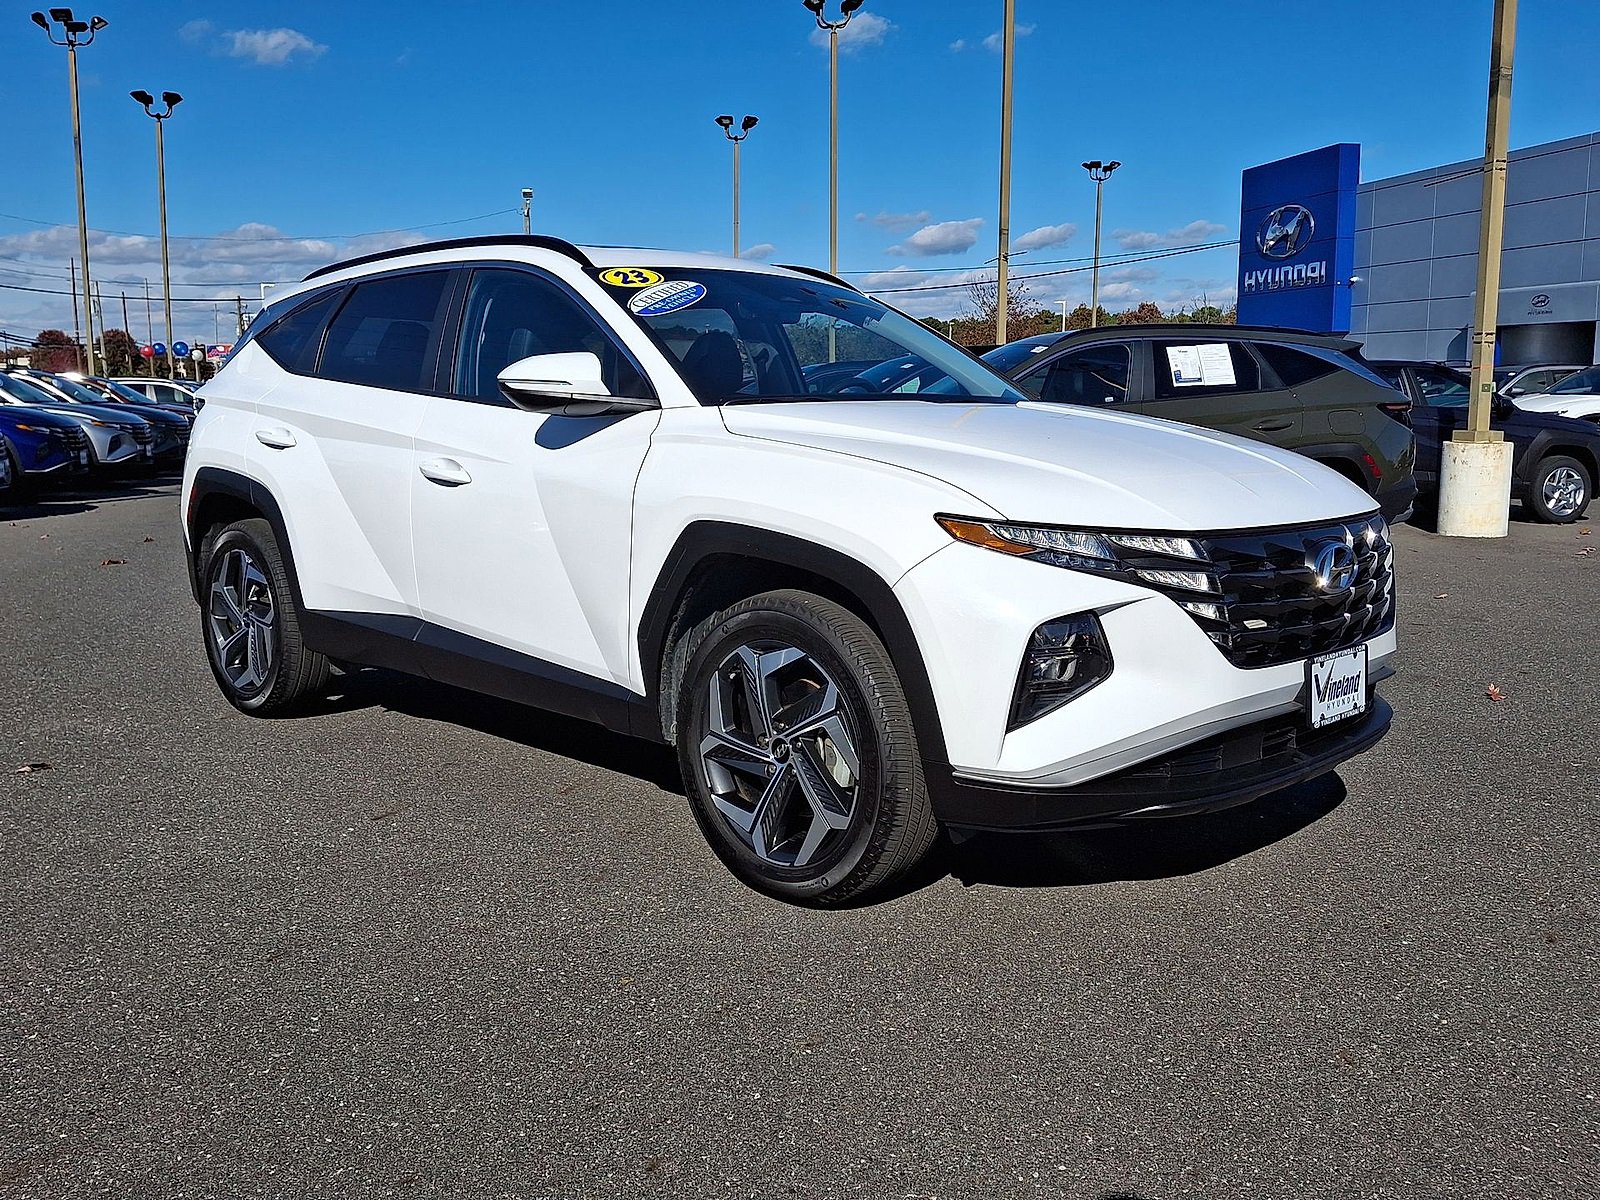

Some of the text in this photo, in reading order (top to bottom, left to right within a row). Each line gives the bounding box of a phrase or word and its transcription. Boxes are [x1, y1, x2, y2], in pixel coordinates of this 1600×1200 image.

[613, 270, 650, 284] 23
[1244, 261, 1327, 292] HYUNDAI
[633, 281, 690, 308] CERTIFIED
[662, 293, 699, 310] VEHICLE
[1314, 660, 1362, 704] Vineland
[1327, 694, 1360, 711] HYUNDAI
